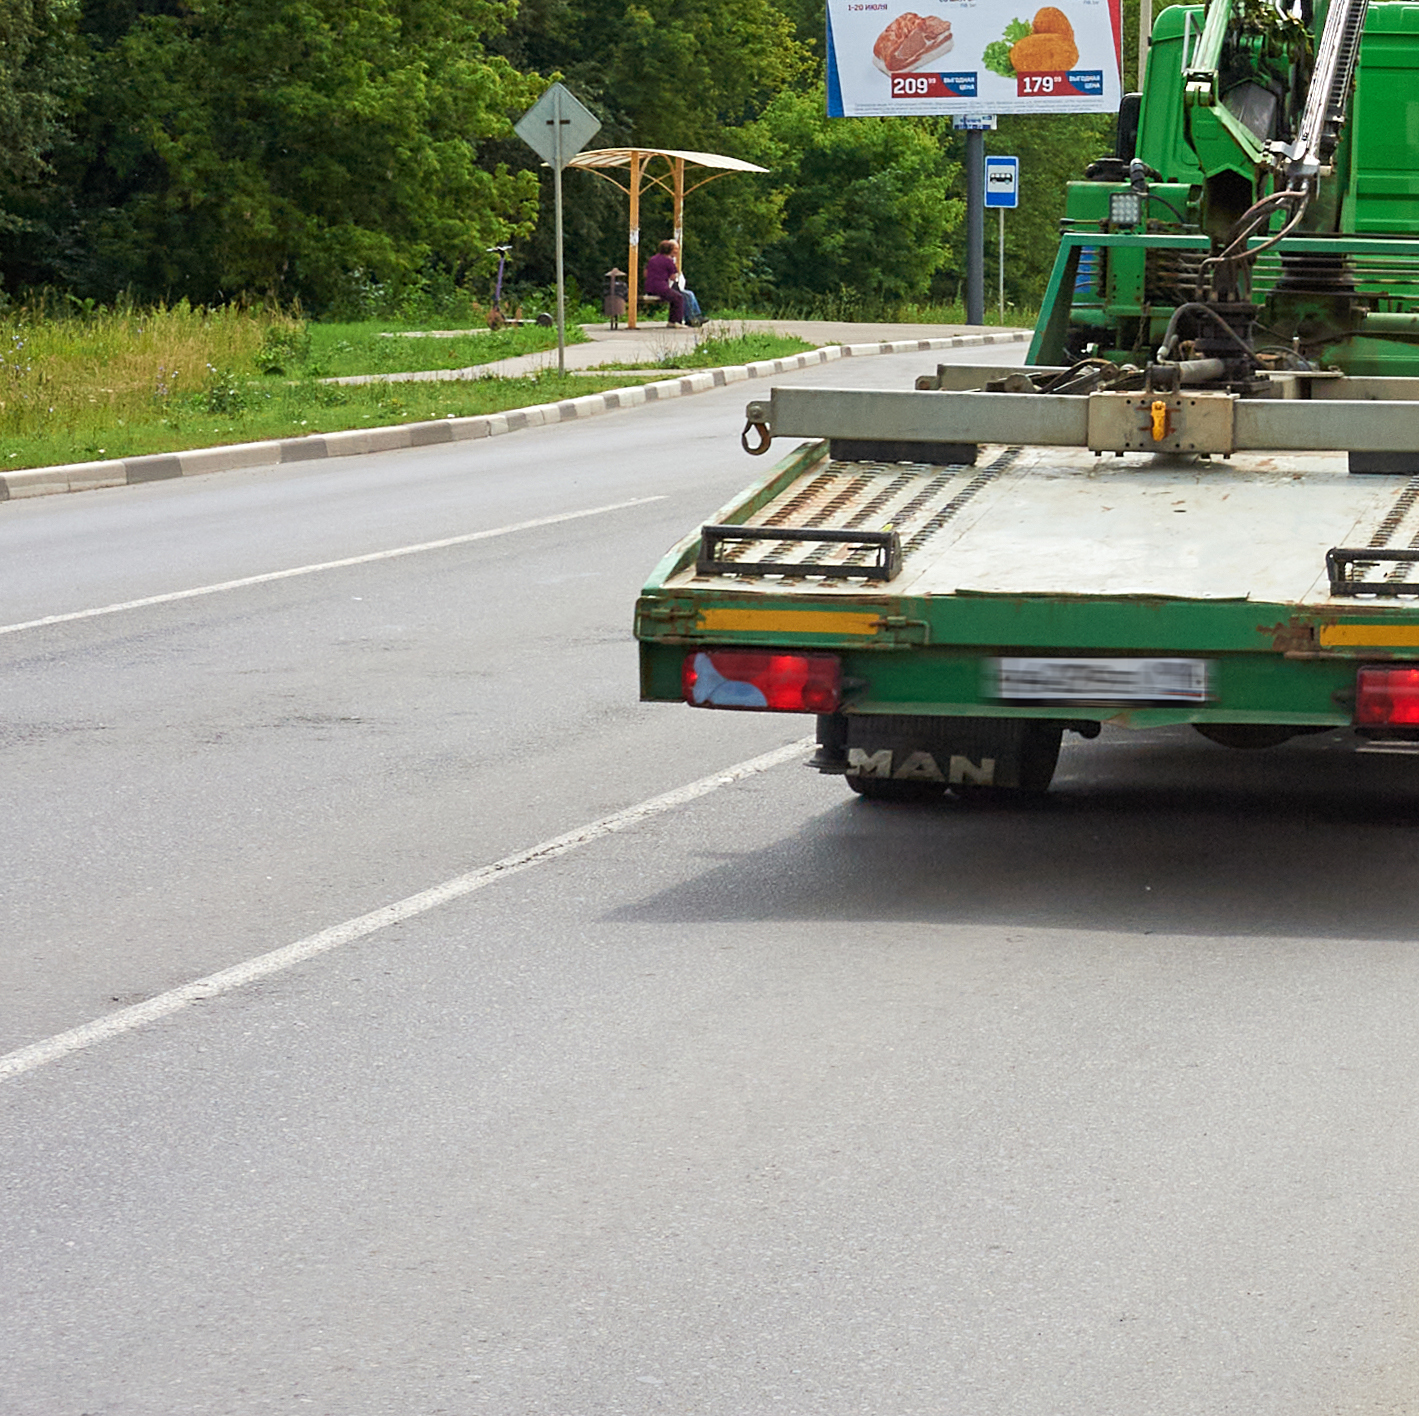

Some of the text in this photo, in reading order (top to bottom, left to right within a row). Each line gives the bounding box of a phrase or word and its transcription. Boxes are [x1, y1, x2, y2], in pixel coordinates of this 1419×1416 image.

[893, 77, 928, 94] 209
[1023, 75, 1054, 93] 179
[846, 747, 996, 785] MAN
